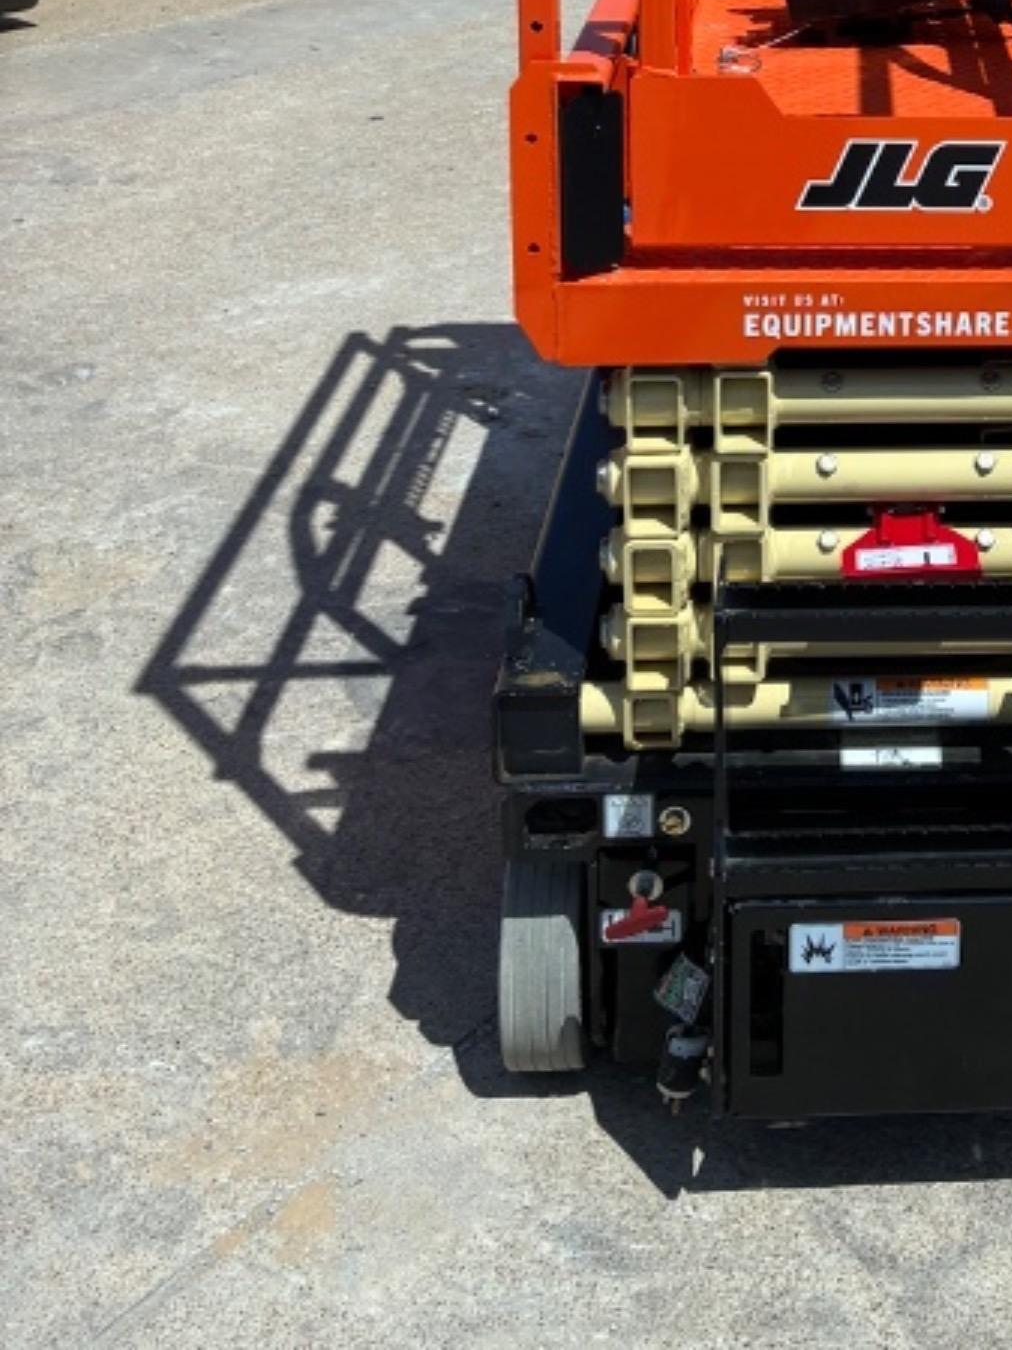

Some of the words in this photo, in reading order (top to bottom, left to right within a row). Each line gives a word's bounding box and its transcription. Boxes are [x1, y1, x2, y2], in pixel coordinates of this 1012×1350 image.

[796, 138, 1007, 212] JLG
[743, 294, 787, 307] VISIT
[794, 294, 813, 307] US
